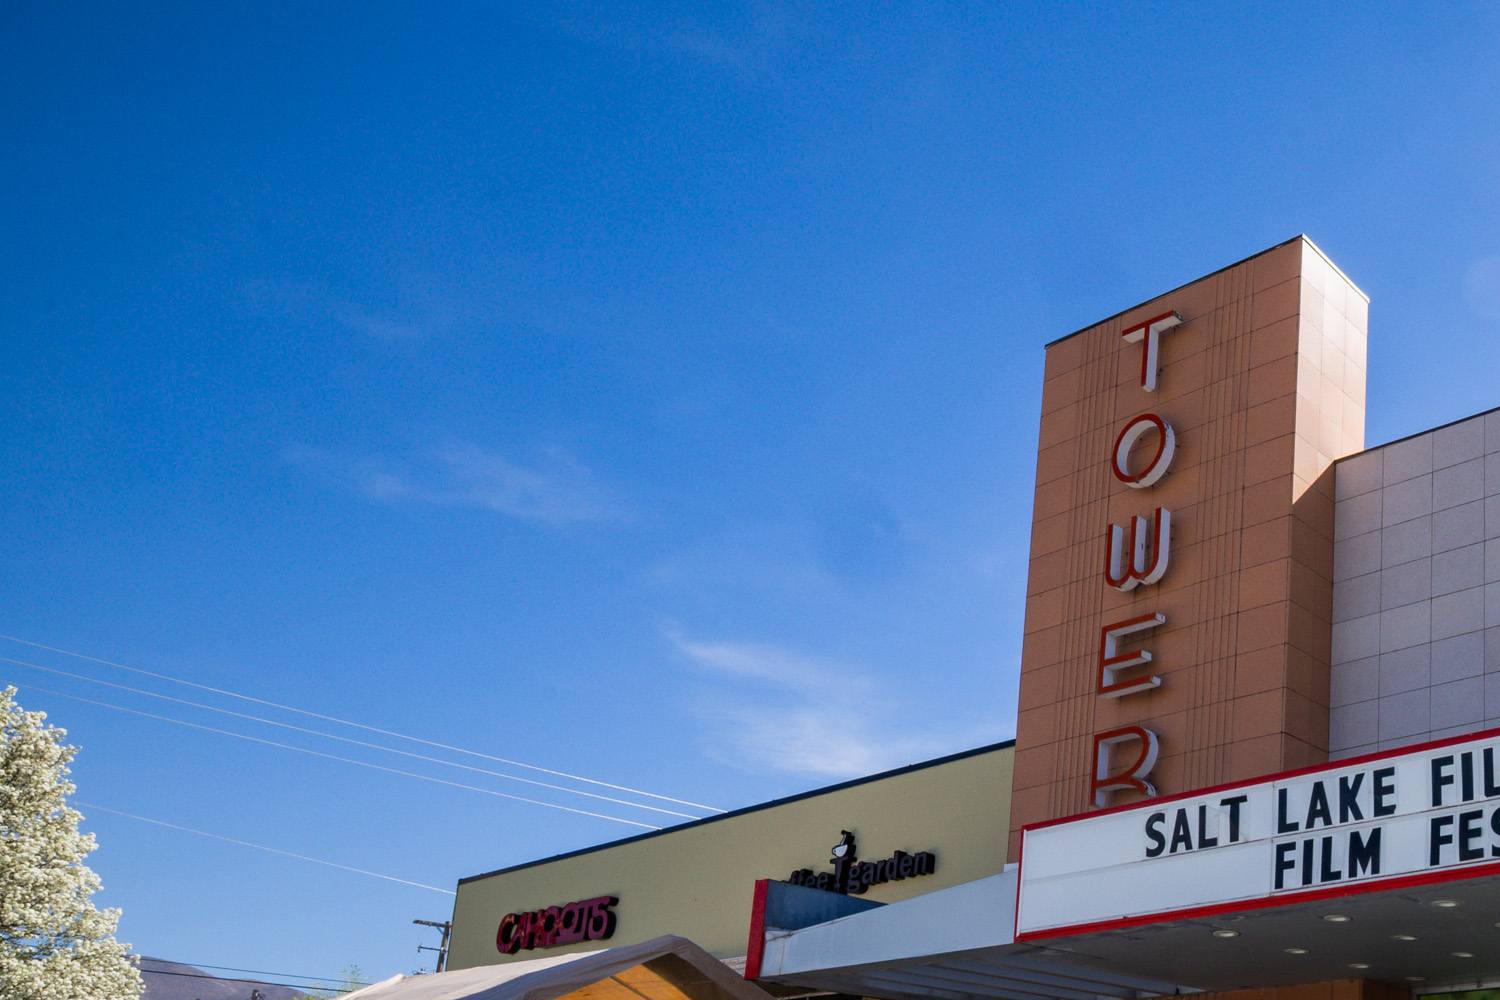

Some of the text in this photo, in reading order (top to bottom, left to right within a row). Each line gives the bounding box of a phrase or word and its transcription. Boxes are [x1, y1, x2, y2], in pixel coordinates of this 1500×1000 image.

[1090, 309, 1183, 808] TOWER
[1146, 795, 1247, 857] SALT
[1278, 767, 1396, 833] LAKE
[789, 850, 935, 895] ffee garden
[1275, 828, 1381, 889] FILM
[497, 896, 618, 953] CAHOOTS
